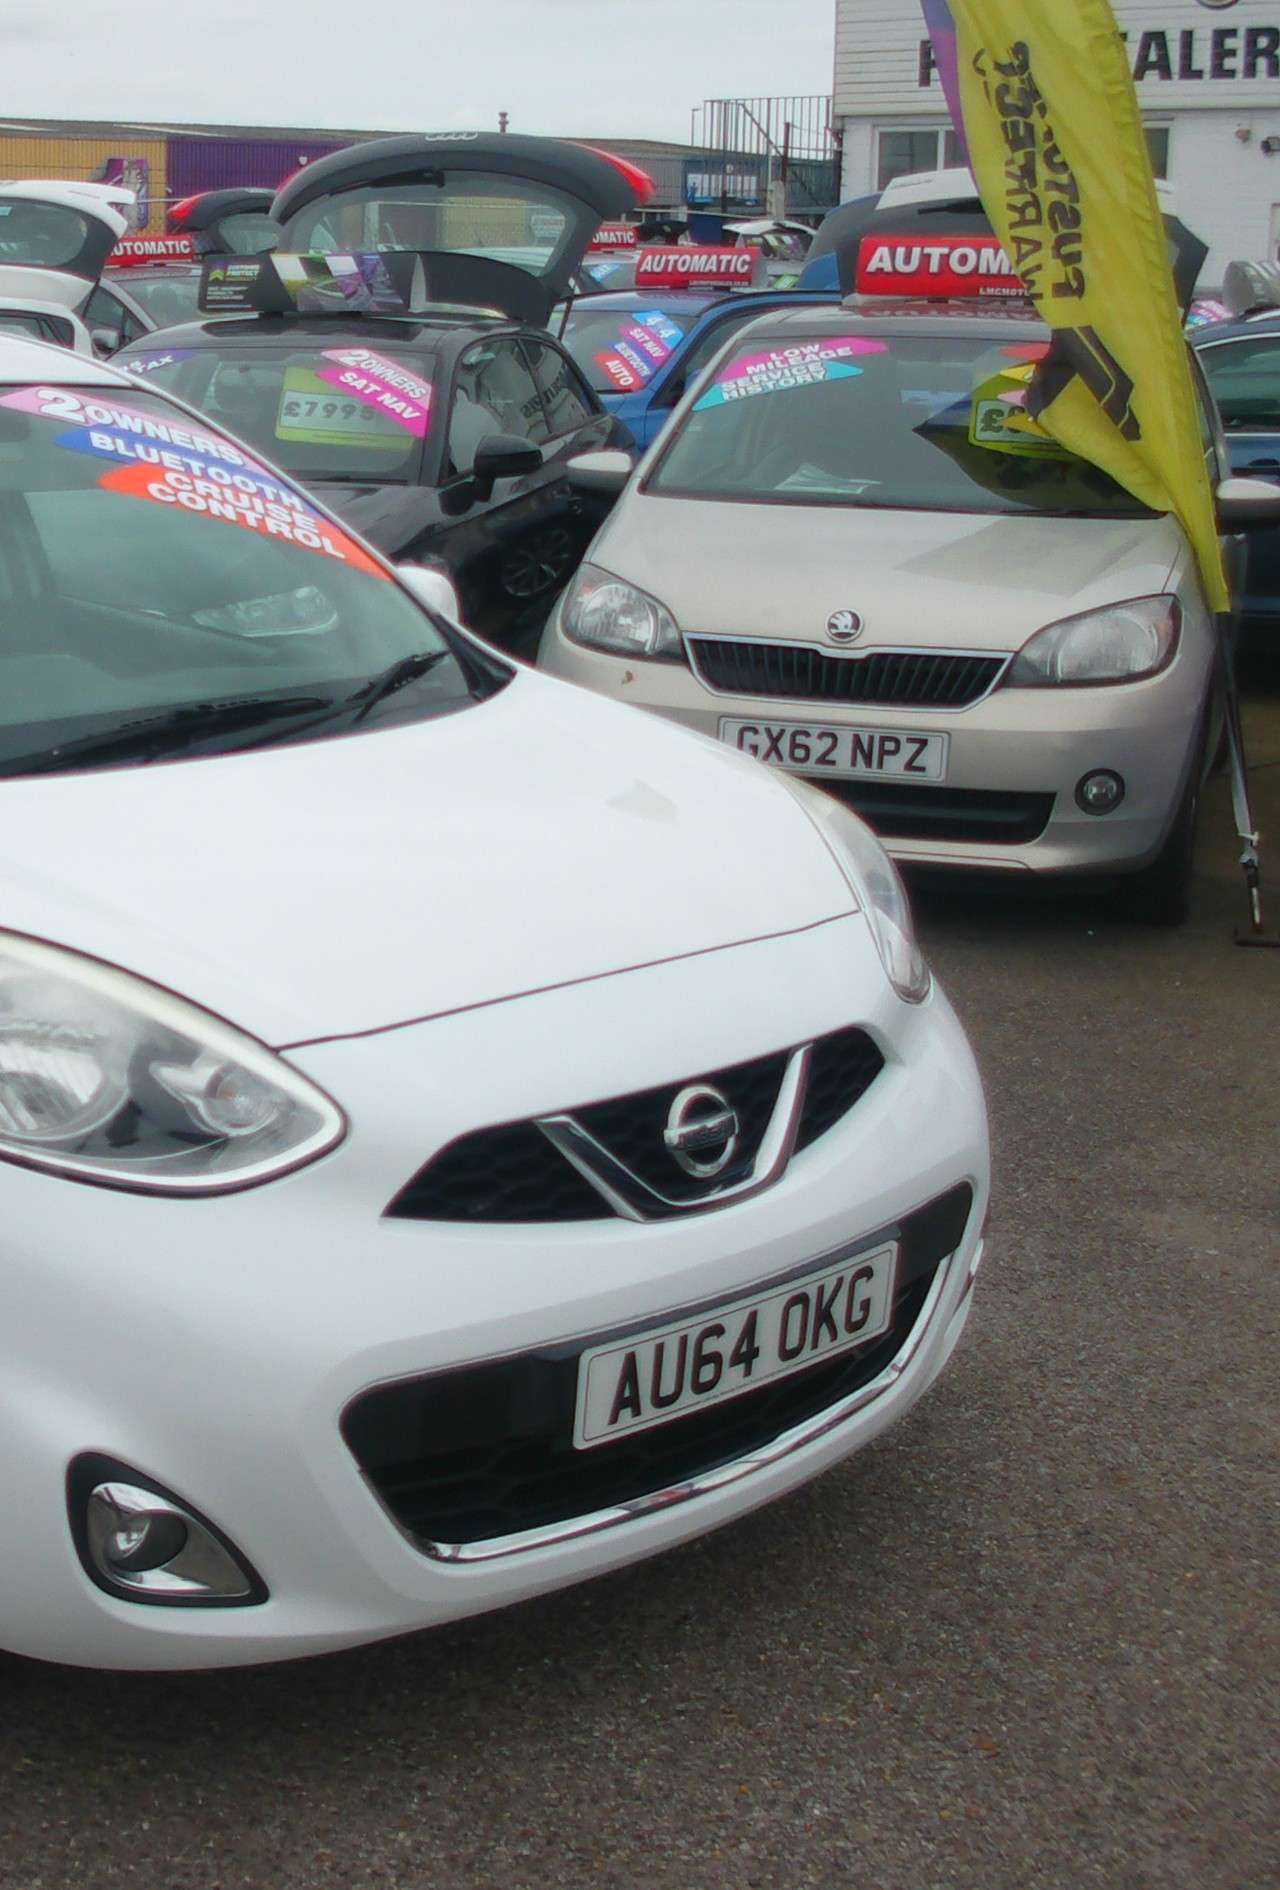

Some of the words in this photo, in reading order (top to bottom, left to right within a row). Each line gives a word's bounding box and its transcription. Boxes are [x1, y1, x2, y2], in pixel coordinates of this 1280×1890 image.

[110, 240, 191, 256] UTOMATIC
[640, 254, 751, 273] AUTOMATIC
[866, 246, 1017, 275] AUTOM
[745, 347, 854, 375] MILEAGE
[770, 344, 821, 361] LOW
[360, 358, 427, 399] OWNERS
[605, 360, 634, 386] AUTO
[721, 363, 826, 391] SERVICE
[722, 371, 828, 401] HISTORY
[339, 372, 381, 394] SAT
[376, 392, 422, 419] NAV
[37, 388, 86, 423] 2
[86, 405, 245, 466] OWNERS
[90, 431, 307, 512] BLUETOOTH
[164, 471, 319, 534] CRUISE
[147, 483, 346, 559] CONTROL
[736, 724, 839, 766] GX62
[850, 732, 929, 773] NPZ
[608, 1309, 760, 1425] AU64
[778, 1265, 874, 1362] OKG
